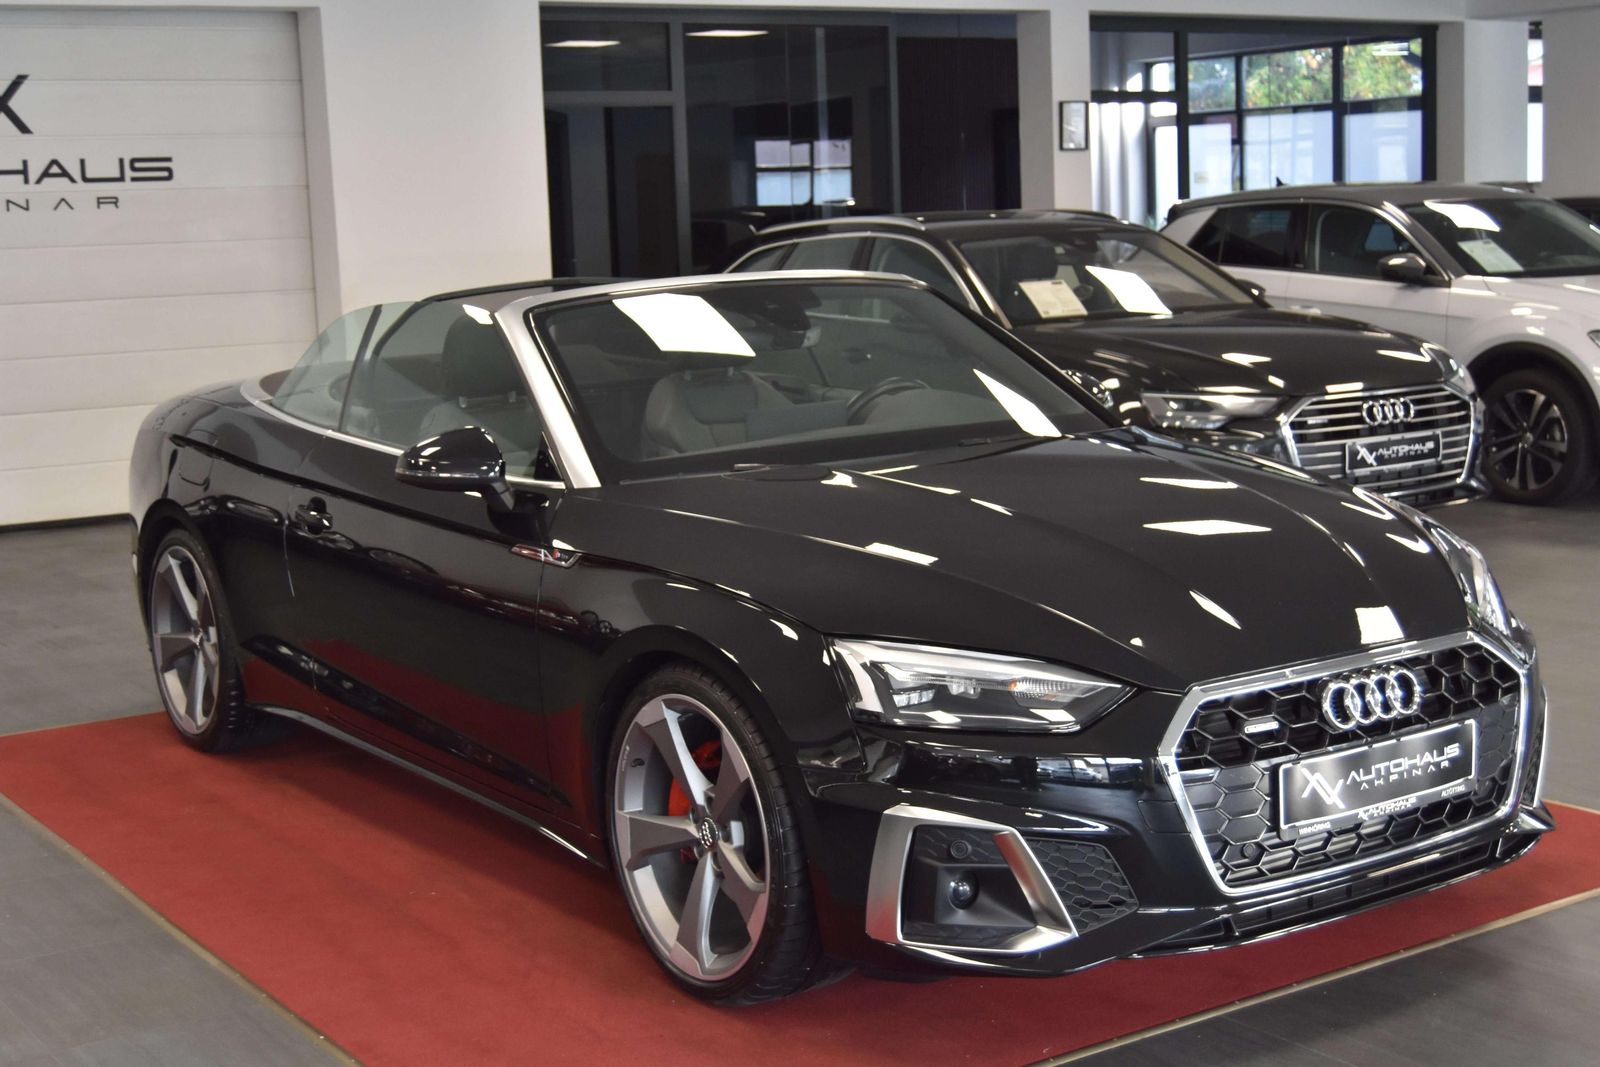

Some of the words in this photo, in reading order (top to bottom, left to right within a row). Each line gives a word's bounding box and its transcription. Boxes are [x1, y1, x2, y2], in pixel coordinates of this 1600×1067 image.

[1377, 441, 1435, 456] AUTOHAUS
[1346, 743, 1460, 784] AUTOHAUS
[1360, 760, 1450, 790] AKPINAR
[1368, 797, 1417, 814] AUTOHAUS
